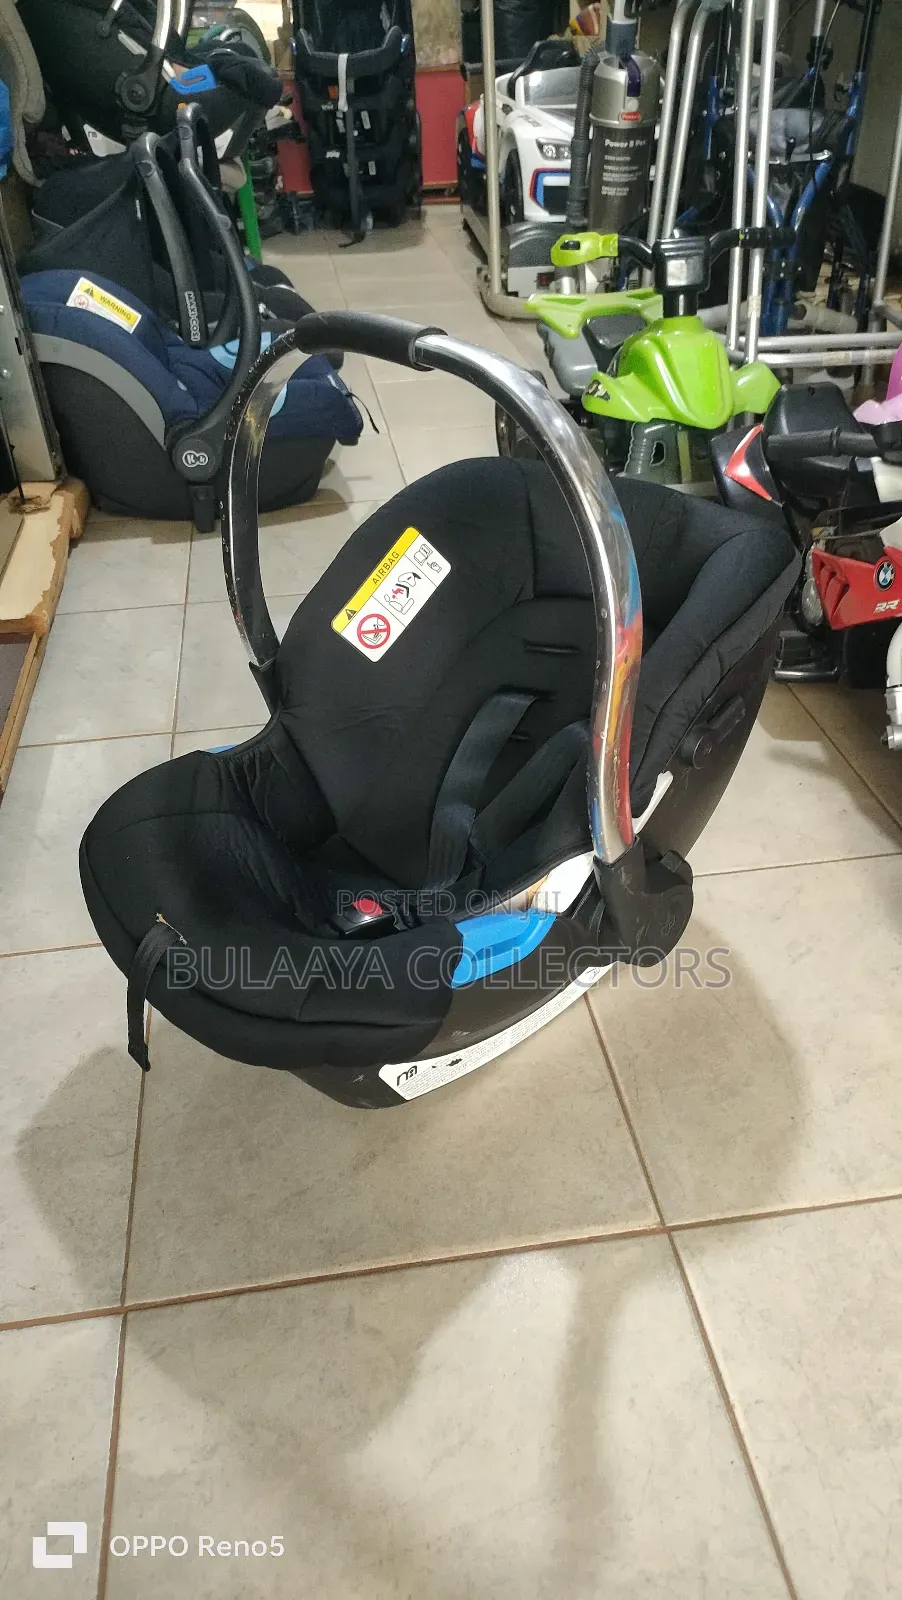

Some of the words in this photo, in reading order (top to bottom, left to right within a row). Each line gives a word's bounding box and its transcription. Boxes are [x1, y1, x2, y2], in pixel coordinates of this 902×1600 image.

[604, 138, 629, 149] Power
[99, 295, 131, 320] WARNING
[372, 550, 400, 586] AIRBAG
[873, 599, 900, 615] RR
